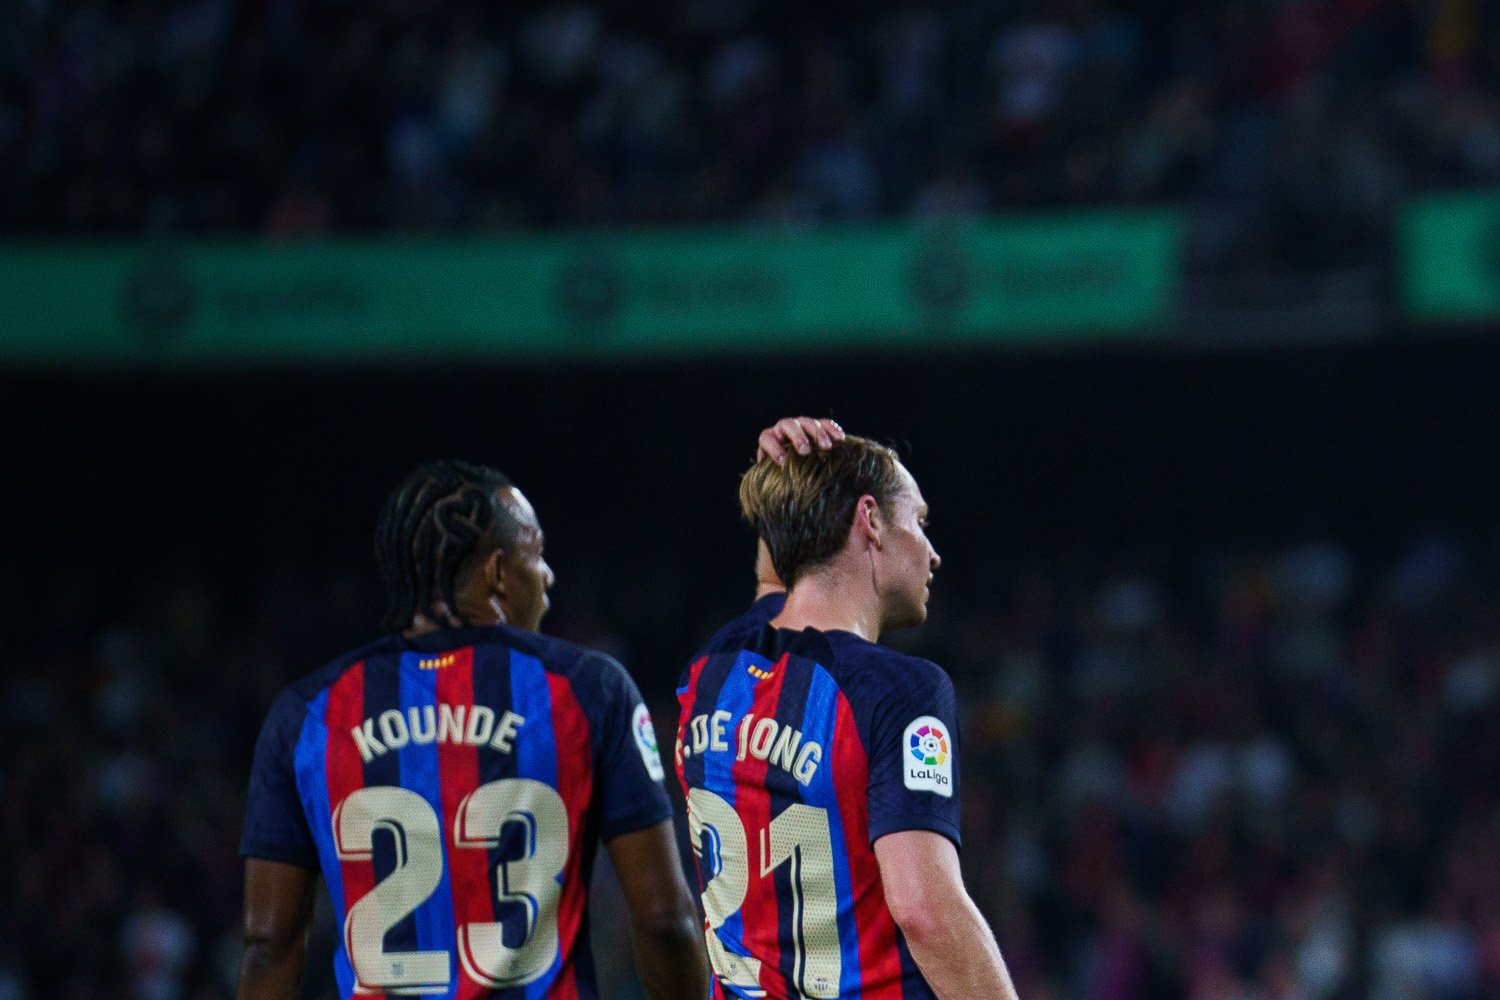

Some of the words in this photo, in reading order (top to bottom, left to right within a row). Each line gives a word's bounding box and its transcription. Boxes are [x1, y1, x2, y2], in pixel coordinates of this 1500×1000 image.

[351, 703, 526, 764] KOUNDE
[736, 713, 822, 787] JONG
[910, 768, 949, 785] LaLiga
[332, 777, 570, 996] 23
